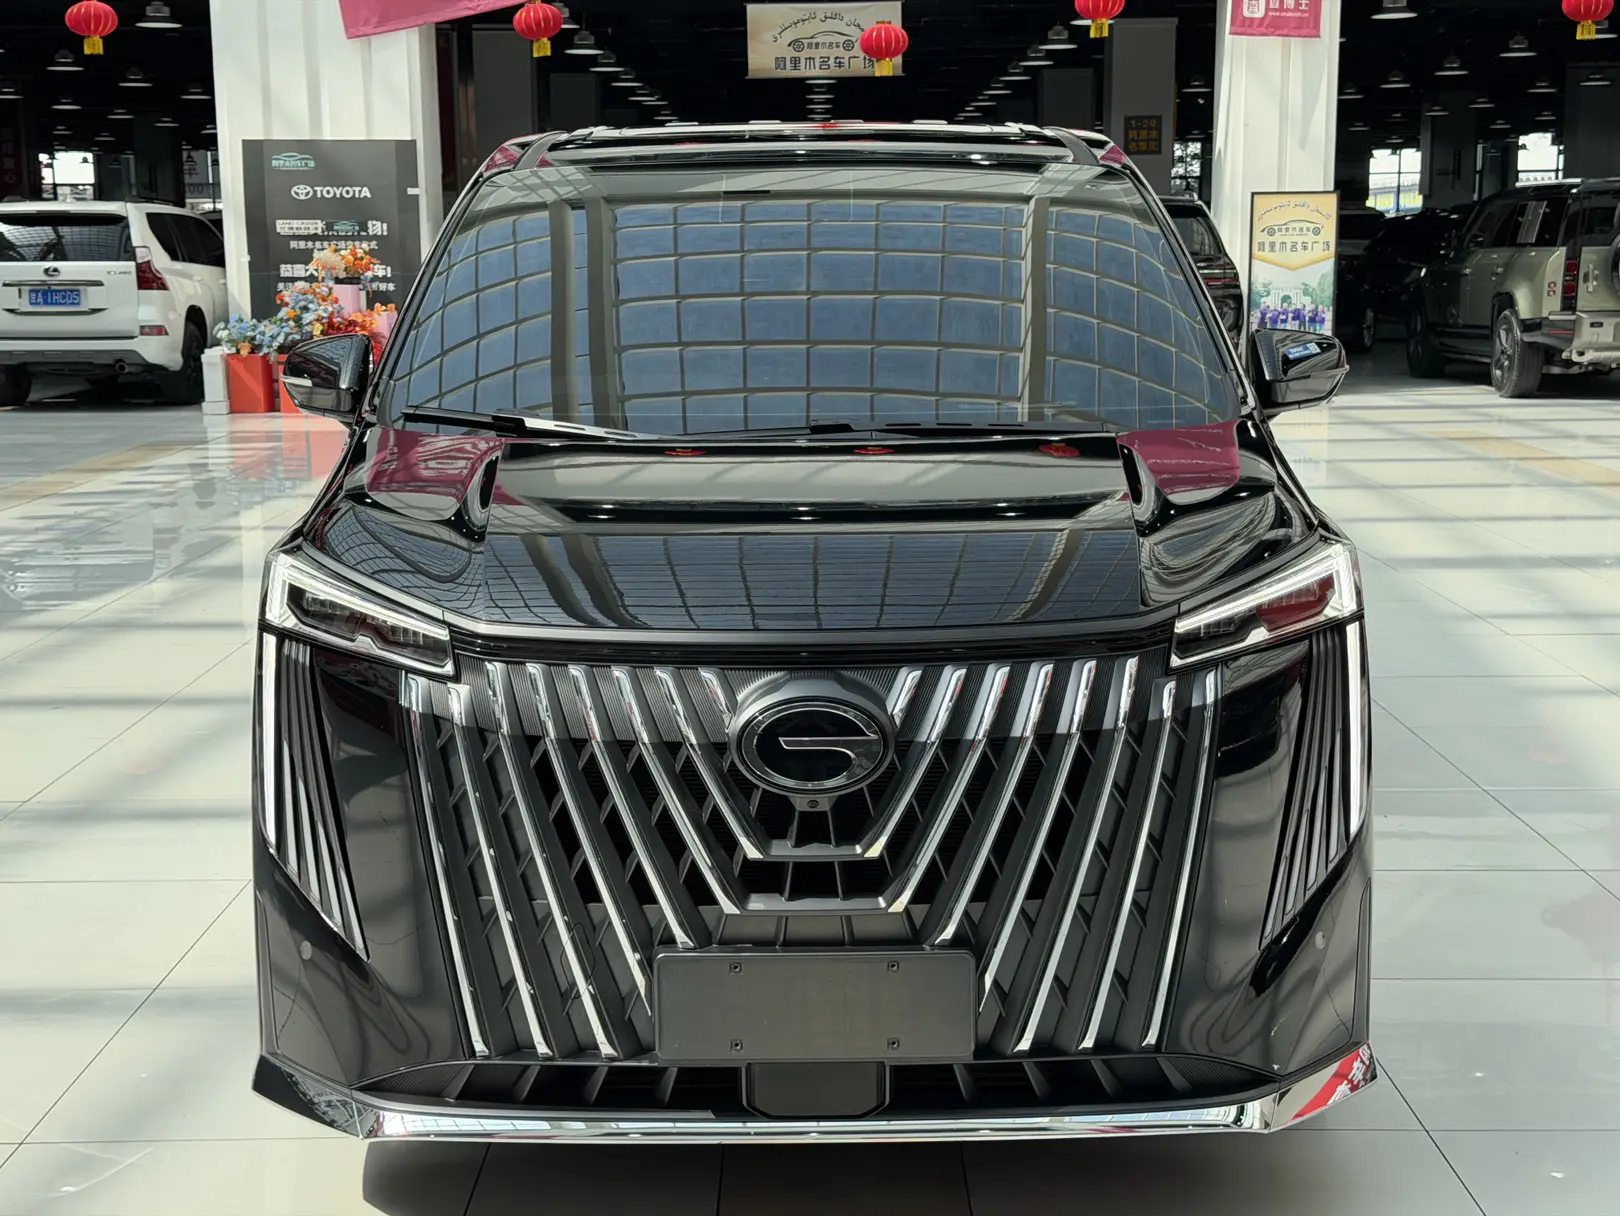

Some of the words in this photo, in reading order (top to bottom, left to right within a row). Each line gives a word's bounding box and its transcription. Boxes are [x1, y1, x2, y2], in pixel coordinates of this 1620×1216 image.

[774, 56, 875, 71] 阿里木名车广场
[314, 186, 372, 199] TOYOTA
[1257, 241, 1331, 253] 阿里木名车广场
